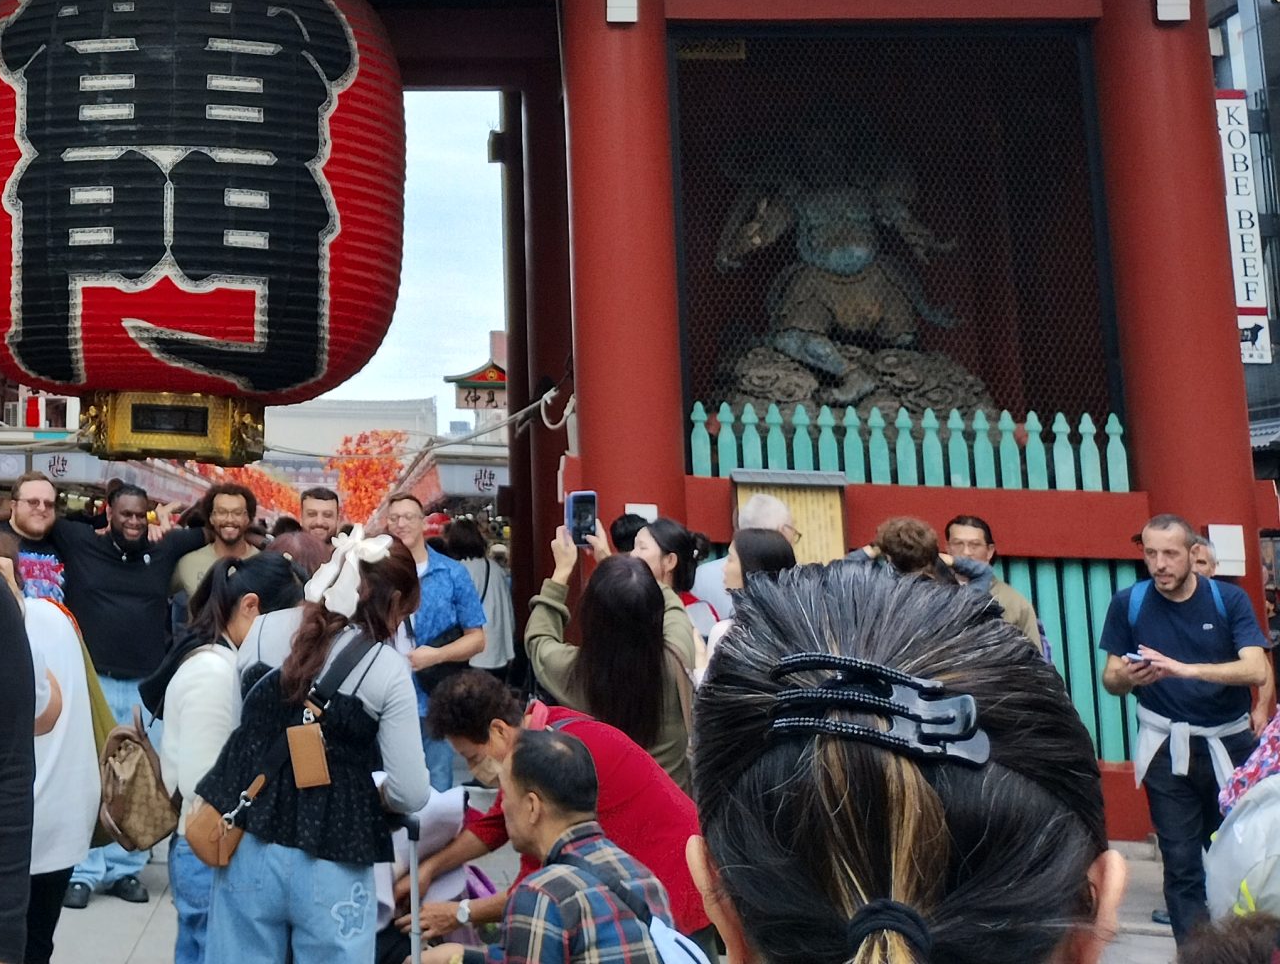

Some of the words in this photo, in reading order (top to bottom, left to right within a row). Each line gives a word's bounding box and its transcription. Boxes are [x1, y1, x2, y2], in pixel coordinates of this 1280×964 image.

[1226, 106, 1251, 196] KOBE
[1235, 209, 1260, 301] BEEF
[464, 388, 507, 409] 仲見
